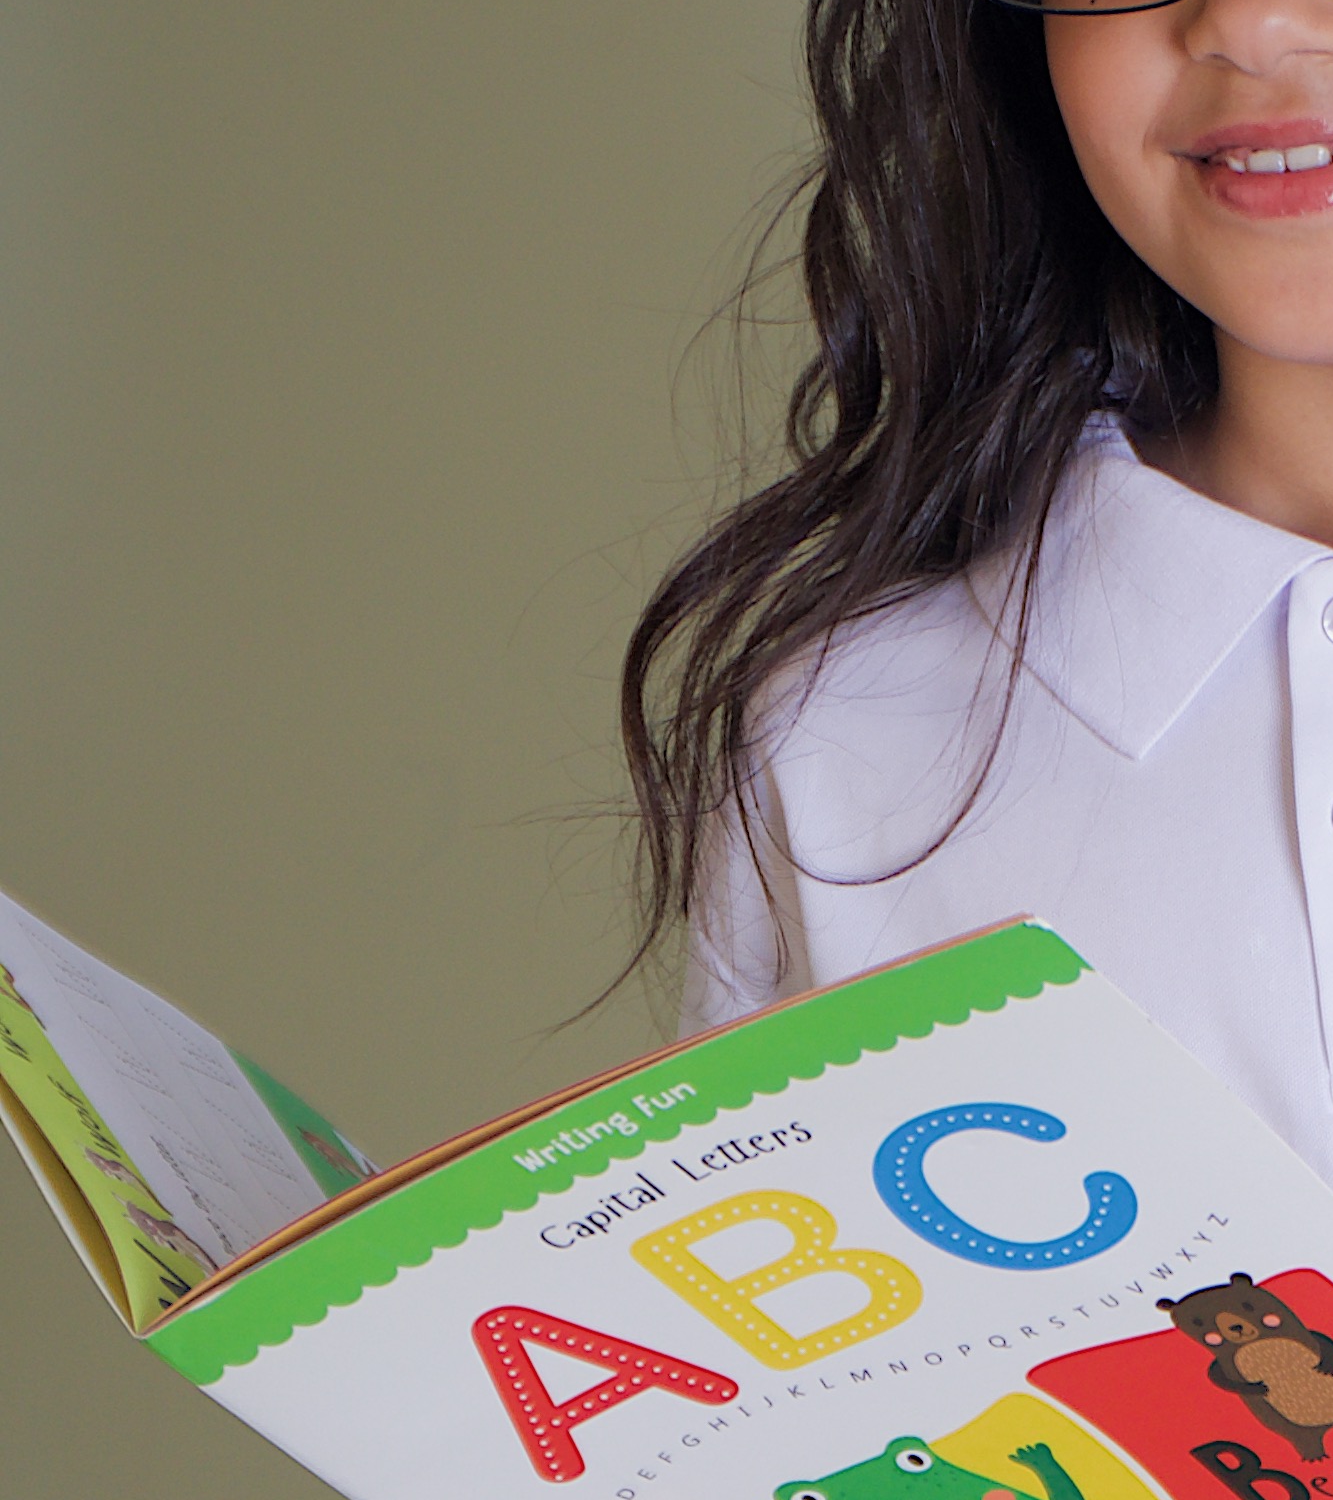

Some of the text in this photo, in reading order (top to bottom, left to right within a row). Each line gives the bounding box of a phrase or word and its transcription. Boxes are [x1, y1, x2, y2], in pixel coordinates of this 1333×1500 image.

[512, 1082, 698, 1174] Writing Fun
[539, 1120, 813, 1250] Capital Letters
